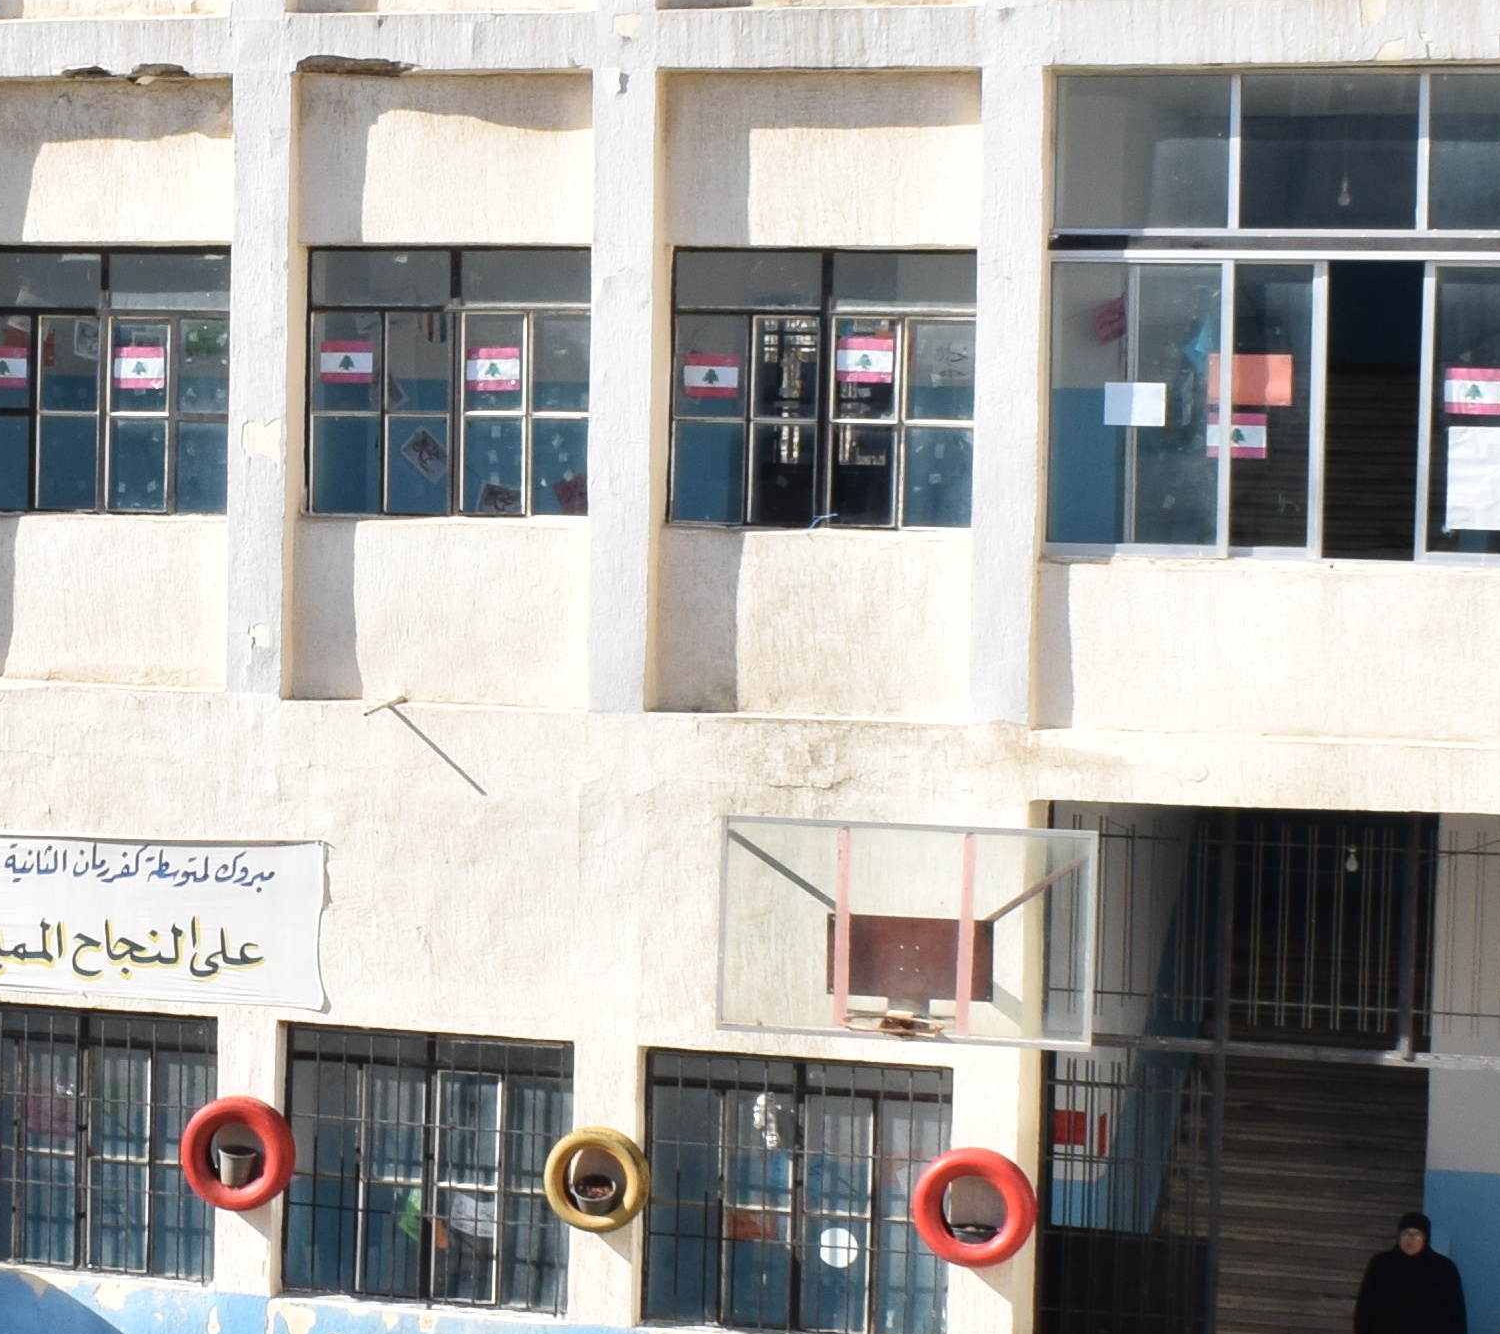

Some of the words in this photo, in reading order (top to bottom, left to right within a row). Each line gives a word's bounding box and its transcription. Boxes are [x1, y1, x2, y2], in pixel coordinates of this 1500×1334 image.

[4, 842, 67, 884] الثانية
[145, 848, 209, 887] لمتوسطة
[213, 850, 275, 893] مبروك
[72, 916, 200, 981] النجاح
[189, 926, 264, 981] على
